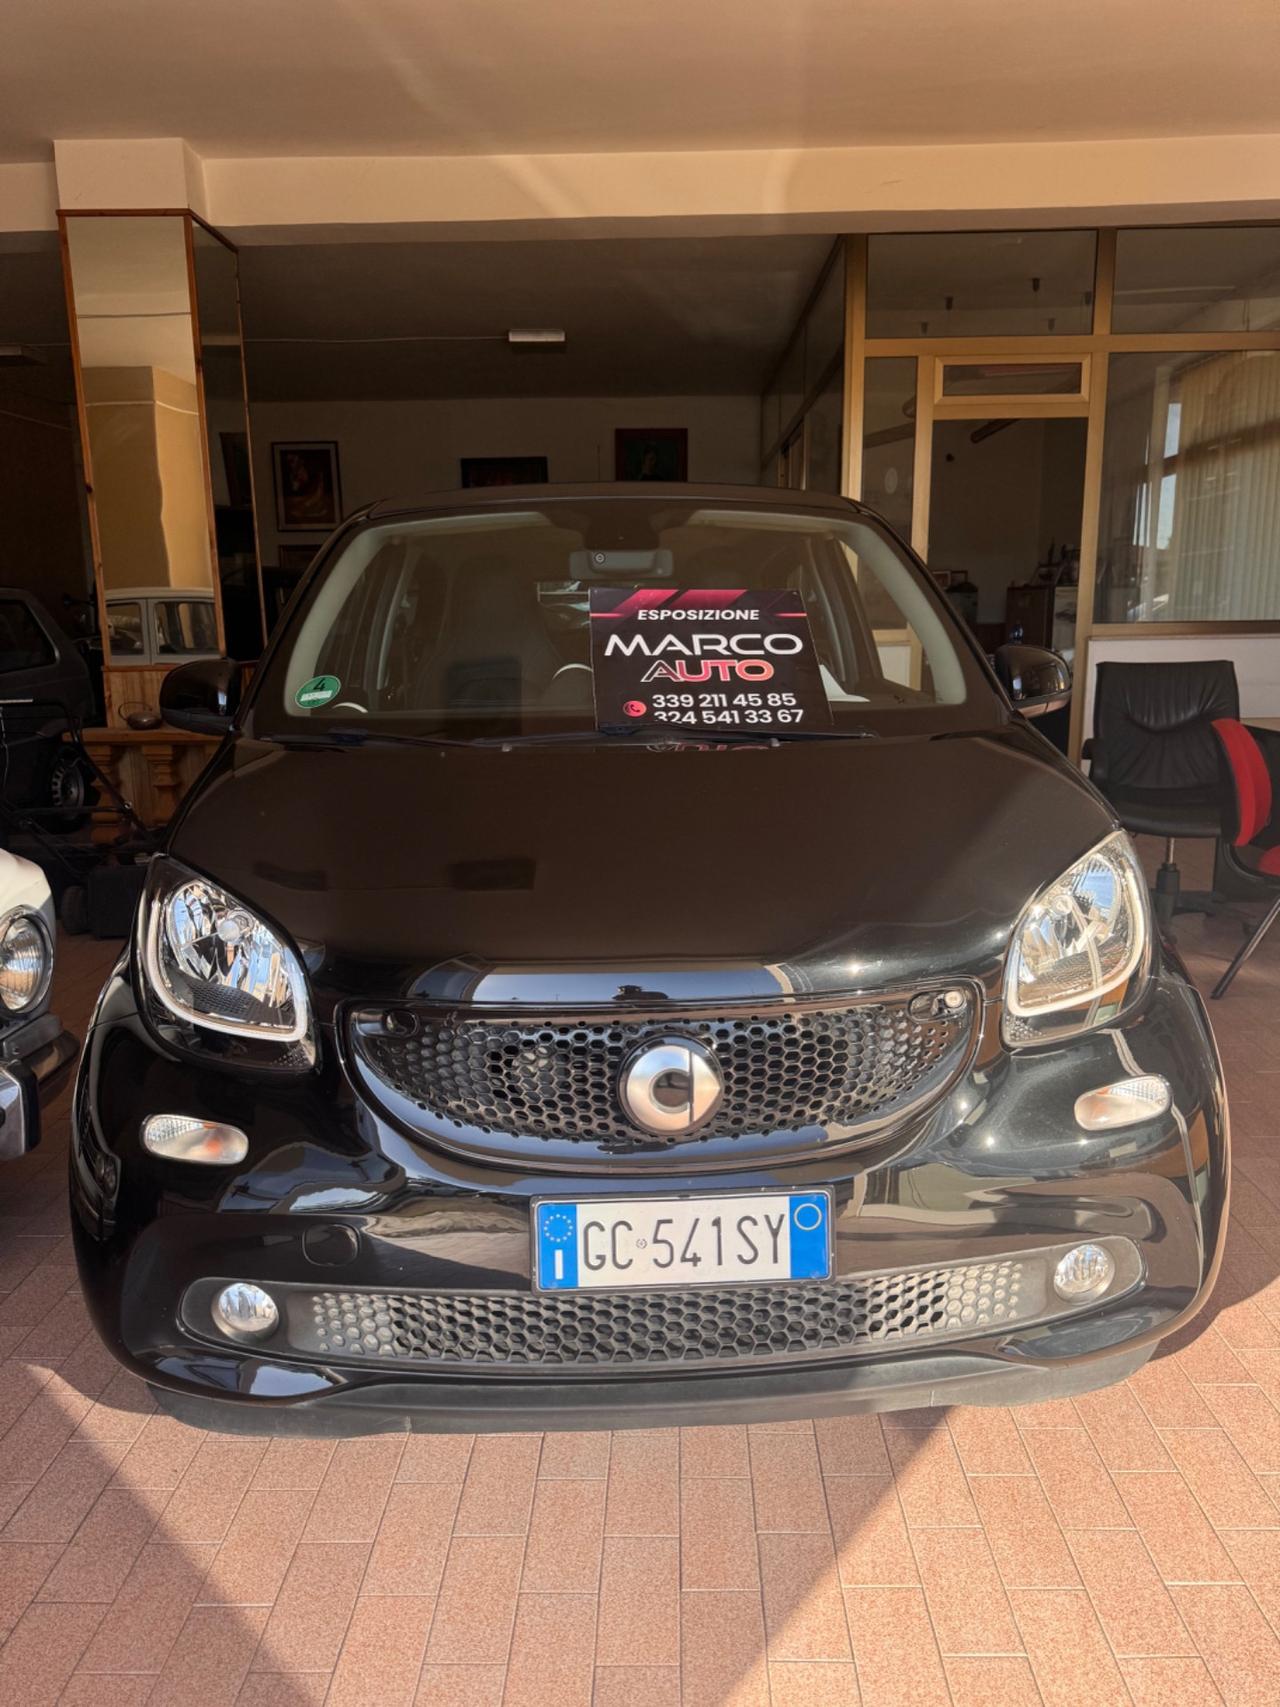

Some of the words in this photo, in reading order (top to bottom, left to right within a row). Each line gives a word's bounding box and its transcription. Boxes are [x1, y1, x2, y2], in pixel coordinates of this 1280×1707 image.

[637, 609, 760, 621] ESPOSIZIONE
[604, 633, 803, 656] MARCO
[640, 659, 775, 683] AUTO
[313, 678, 326, 691] 4
[652, 694, 693, 708] 339
[699, 693, 728, 707] 211
[733, 693, 763, 707] 45
[767, 692, 796, 707] 85
[702, 709, 740, 724] 541
[744, 709, 772, 724] 33
[777, 708, 804, 723] 67
[583, 1220, 633, 1271] GC
[652, 1213, 785, 1269] 541SY
